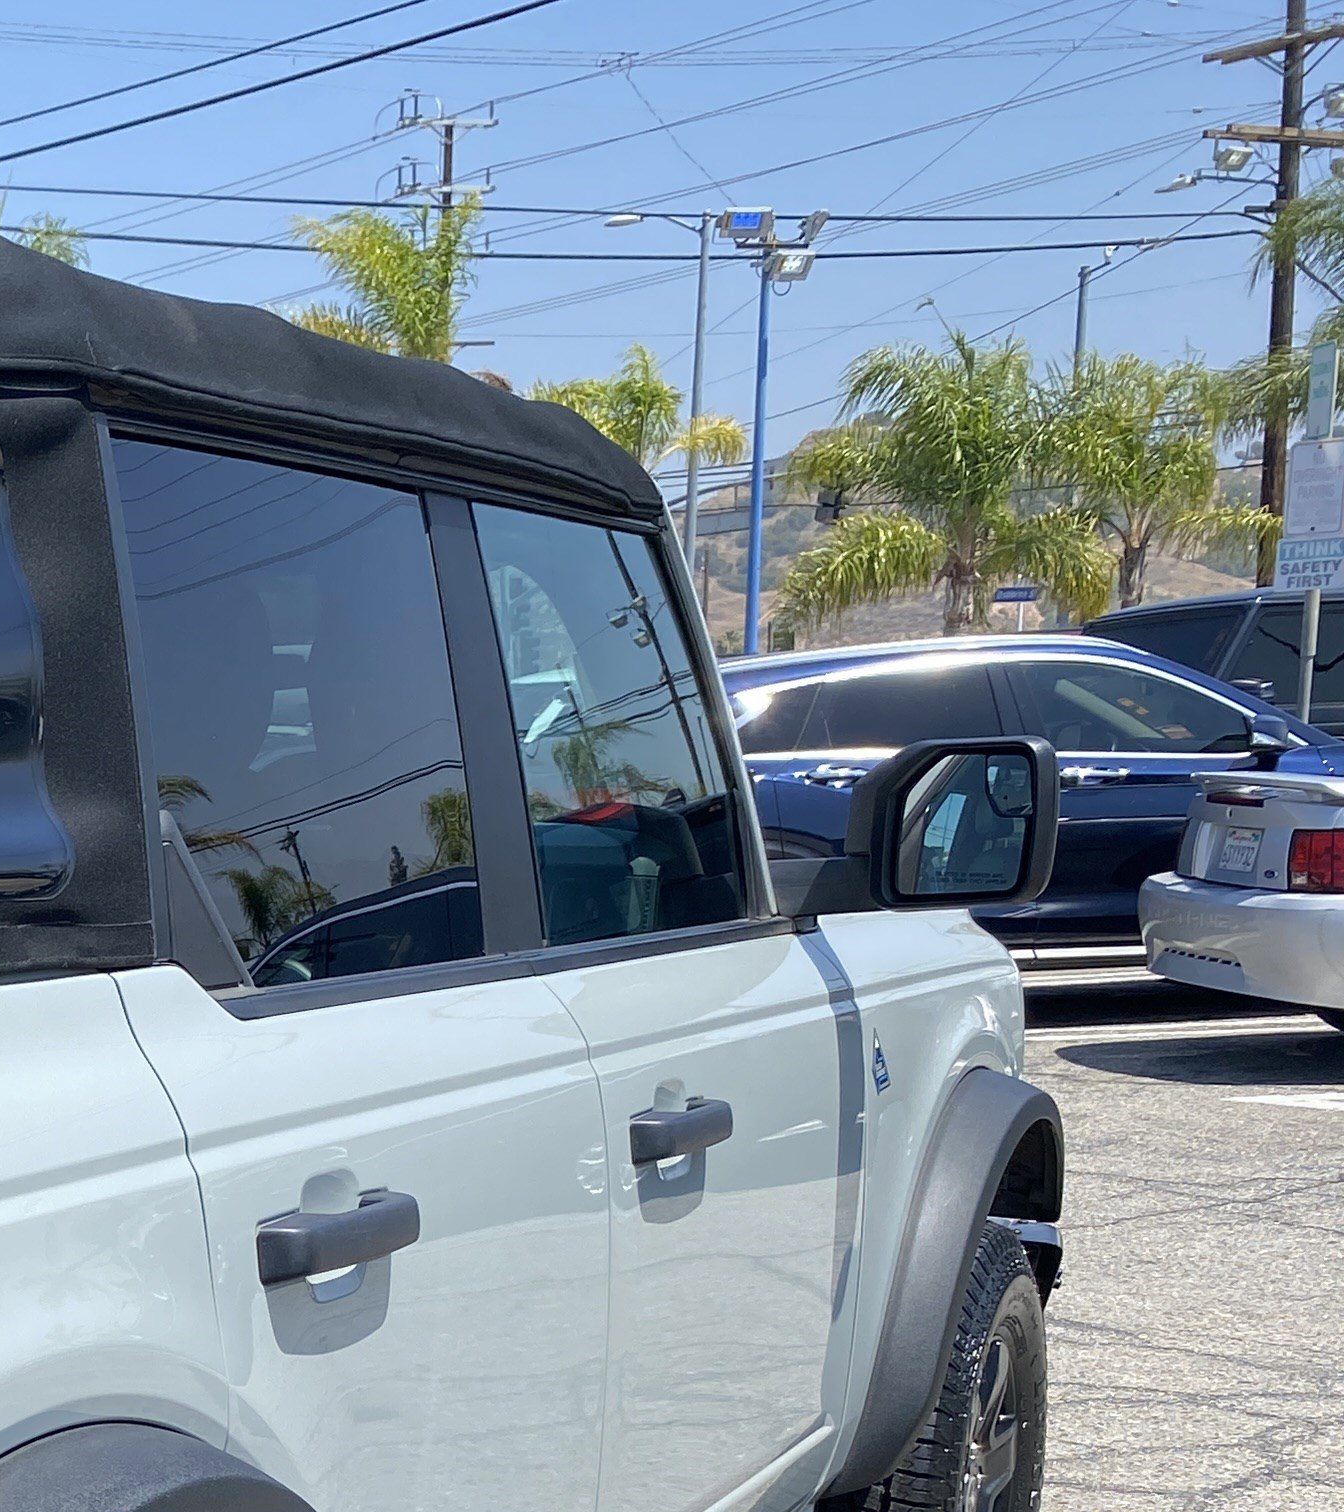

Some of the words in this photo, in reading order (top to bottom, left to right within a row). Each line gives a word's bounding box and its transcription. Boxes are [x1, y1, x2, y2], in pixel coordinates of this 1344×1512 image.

[1282, 540, 1344, 559] THINK
[1280, 559, 1343, 575] SAFETY
[1286, 573, 1334, 589] FIRST
